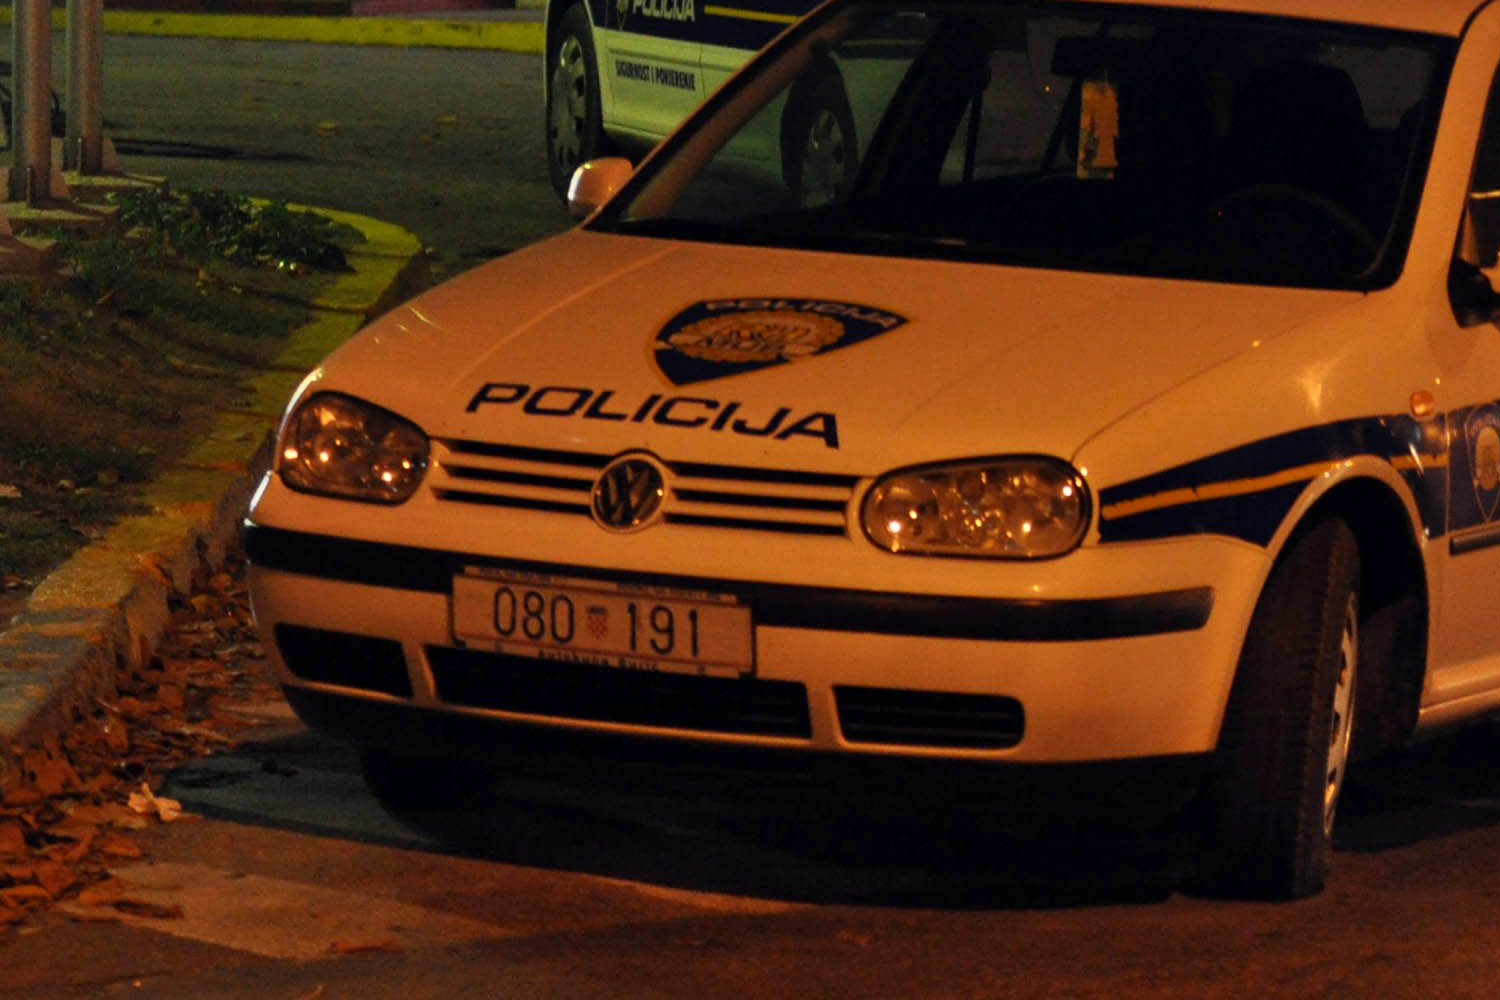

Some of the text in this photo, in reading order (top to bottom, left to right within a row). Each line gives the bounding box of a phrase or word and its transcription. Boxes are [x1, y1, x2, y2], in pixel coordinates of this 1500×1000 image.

[464, 382, 840, 450] POLICIJA
[493, 586, 699, 658] 080 191
